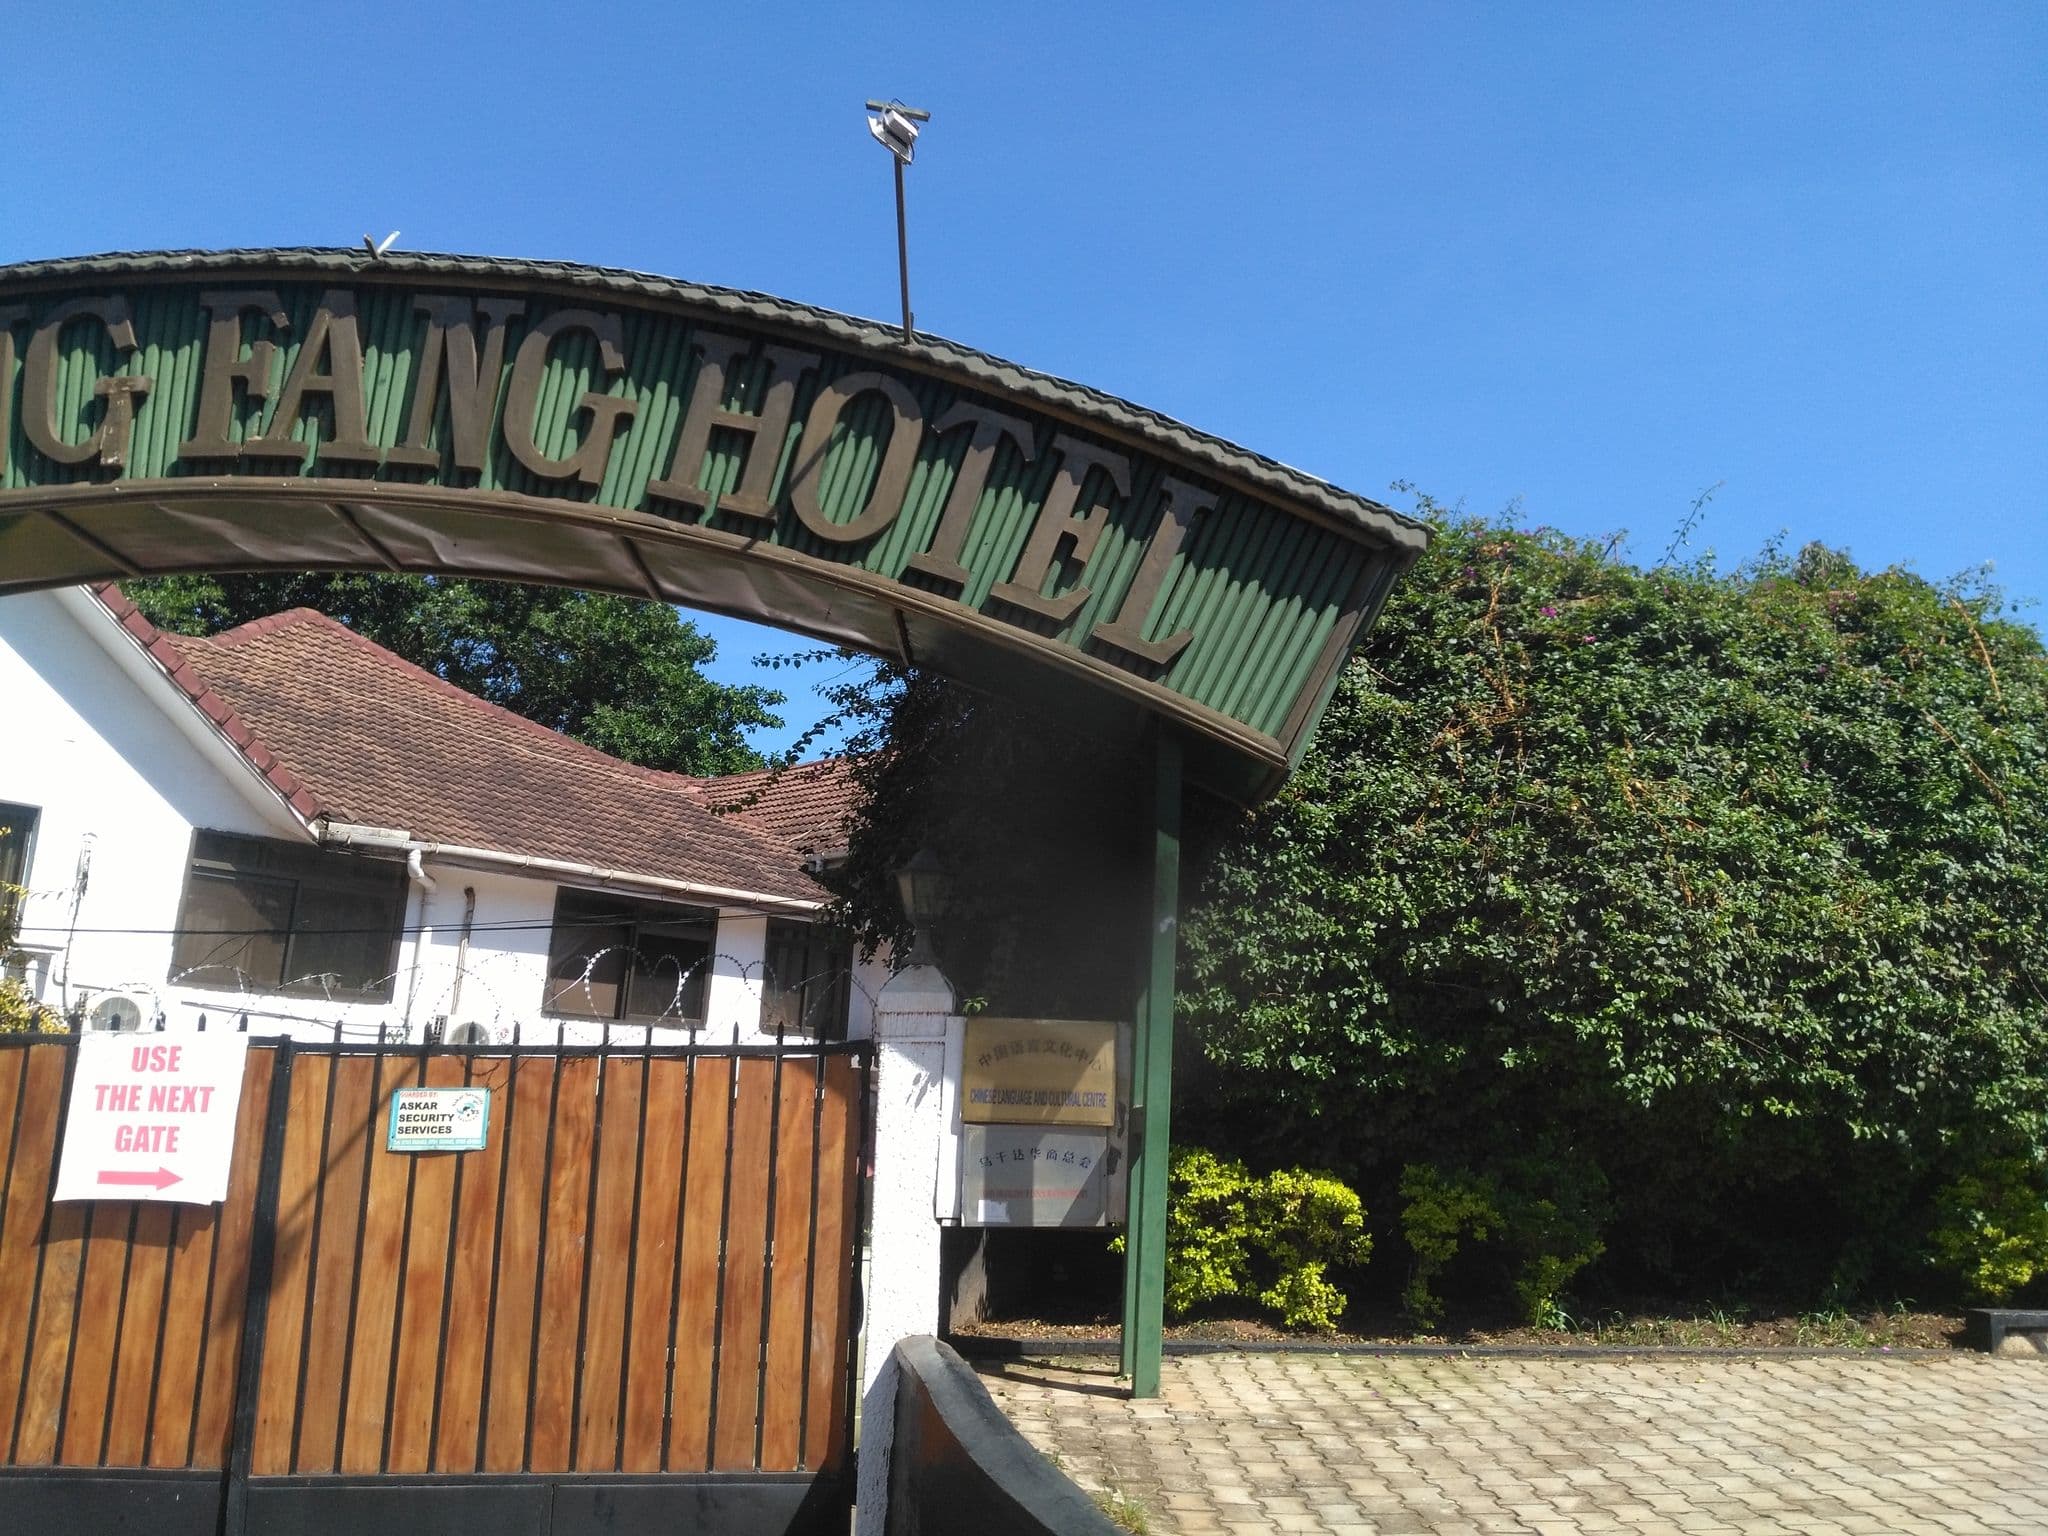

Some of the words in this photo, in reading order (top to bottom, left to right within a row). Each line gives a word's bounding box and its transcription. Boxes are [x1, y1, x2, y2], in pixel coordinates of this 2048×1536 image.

[648, 331, 1219, 664] HOTEL
[131, 1046, 182, 1072] USE
[95, 1085, 142, 1111] THE
[148, 1086, 215, 1112] NEXT
[400, 1102, 438, 1110] ASKAR
[970, 1088, 996, 1104] CHINESE
[998, 1088, 1032, 1105] LANGUAGE
[1033, 1089, 1047, 1105] AND
[1048, 1089, 1081, 1107] CULTURAL
[1083, 1091, 1106, 1107] CENTRE
[398, 1114, 454, 1122] SECURITY
[115, 1125, 180, 1153] GATE
[397, 1126, 452, 1134] SERVICES
